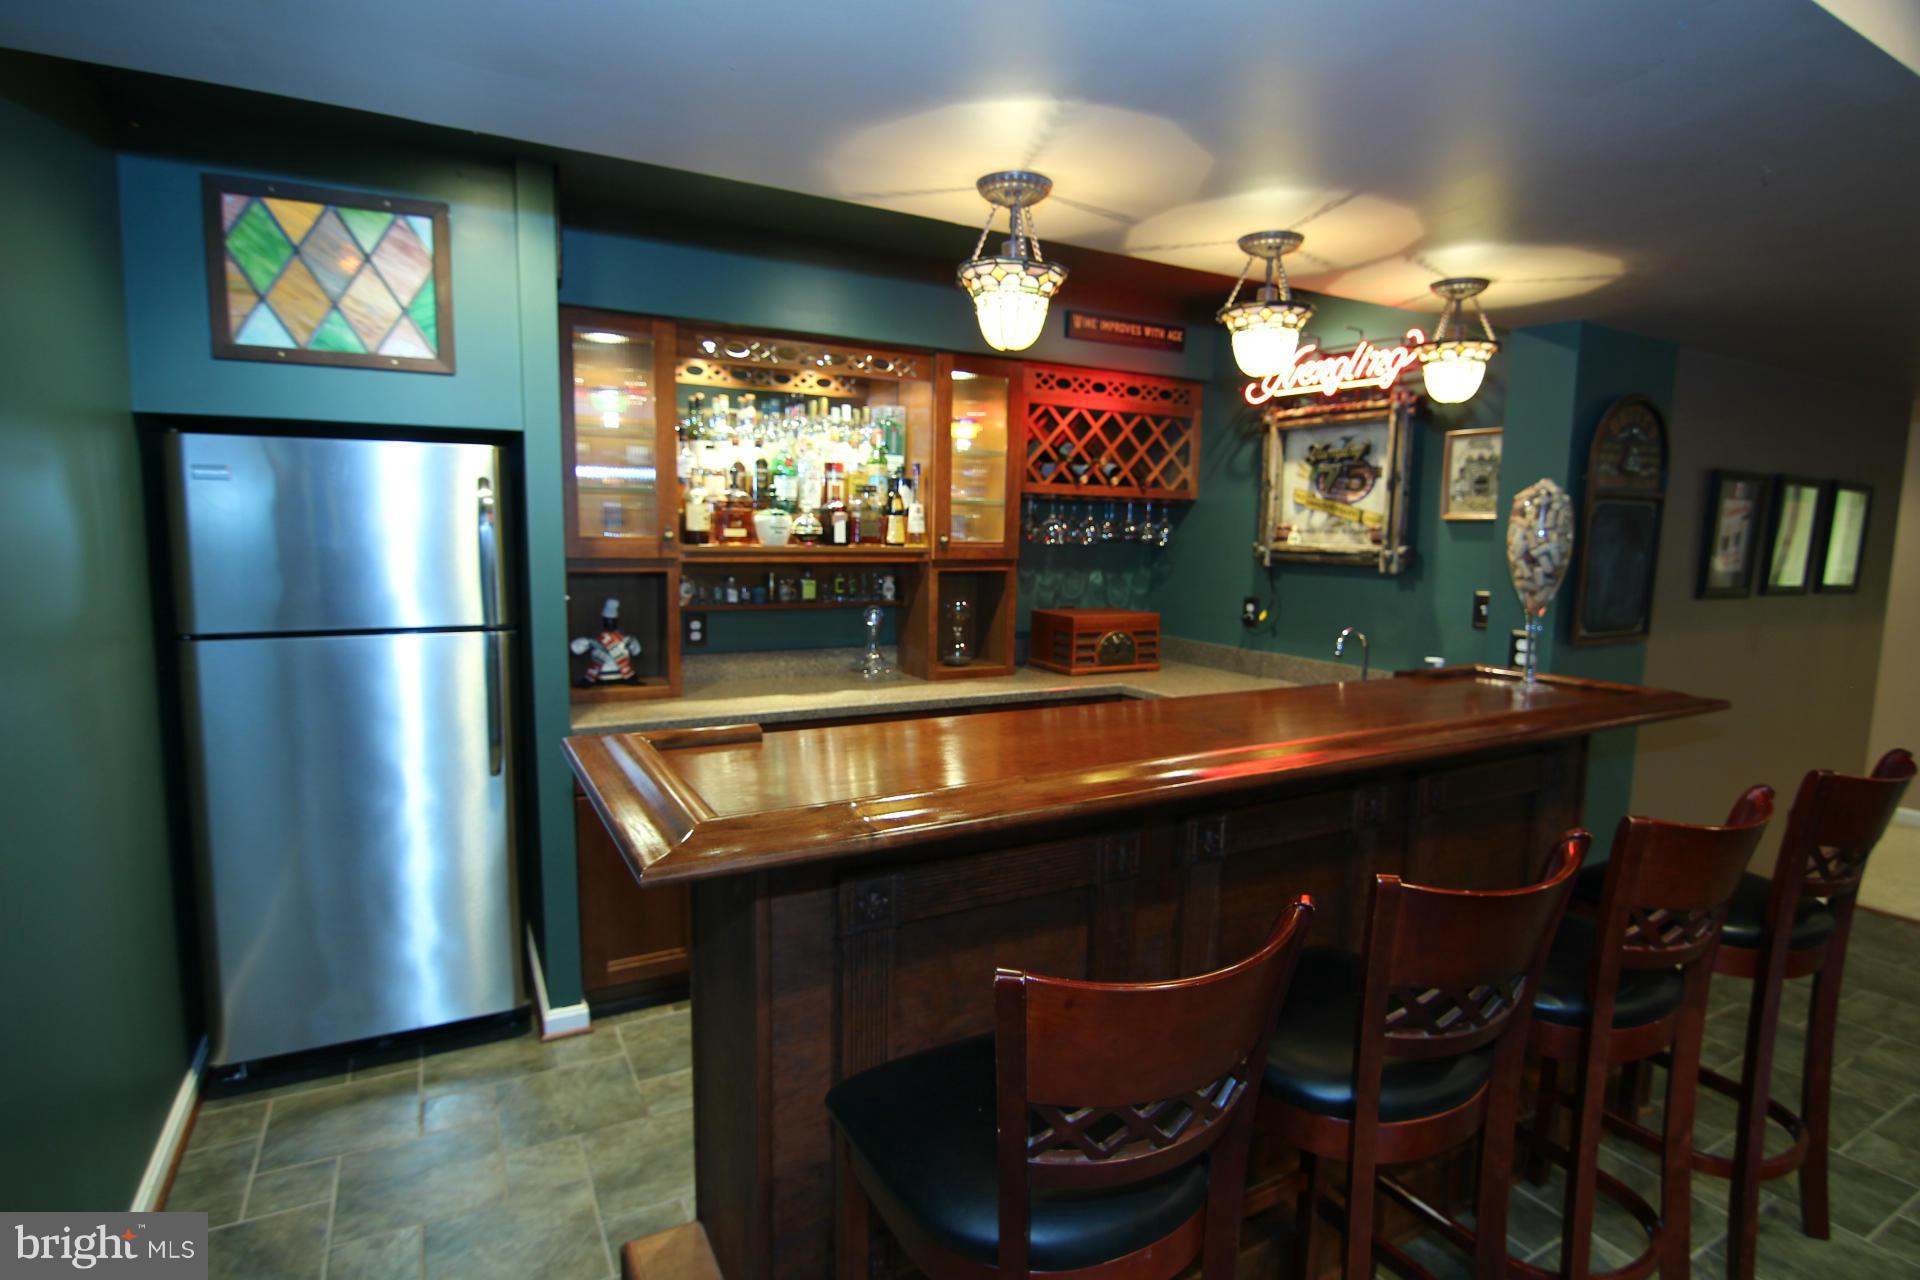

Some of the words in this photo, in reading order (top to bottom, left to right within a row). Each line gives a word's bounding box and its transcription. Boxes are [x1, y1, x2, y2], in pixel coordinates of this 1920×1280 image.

[1099, 319, 1142, 337] IMPROVES
[1143, 326, 1166, 340] WITH
[1167, 329, 1183, 342] AGE
